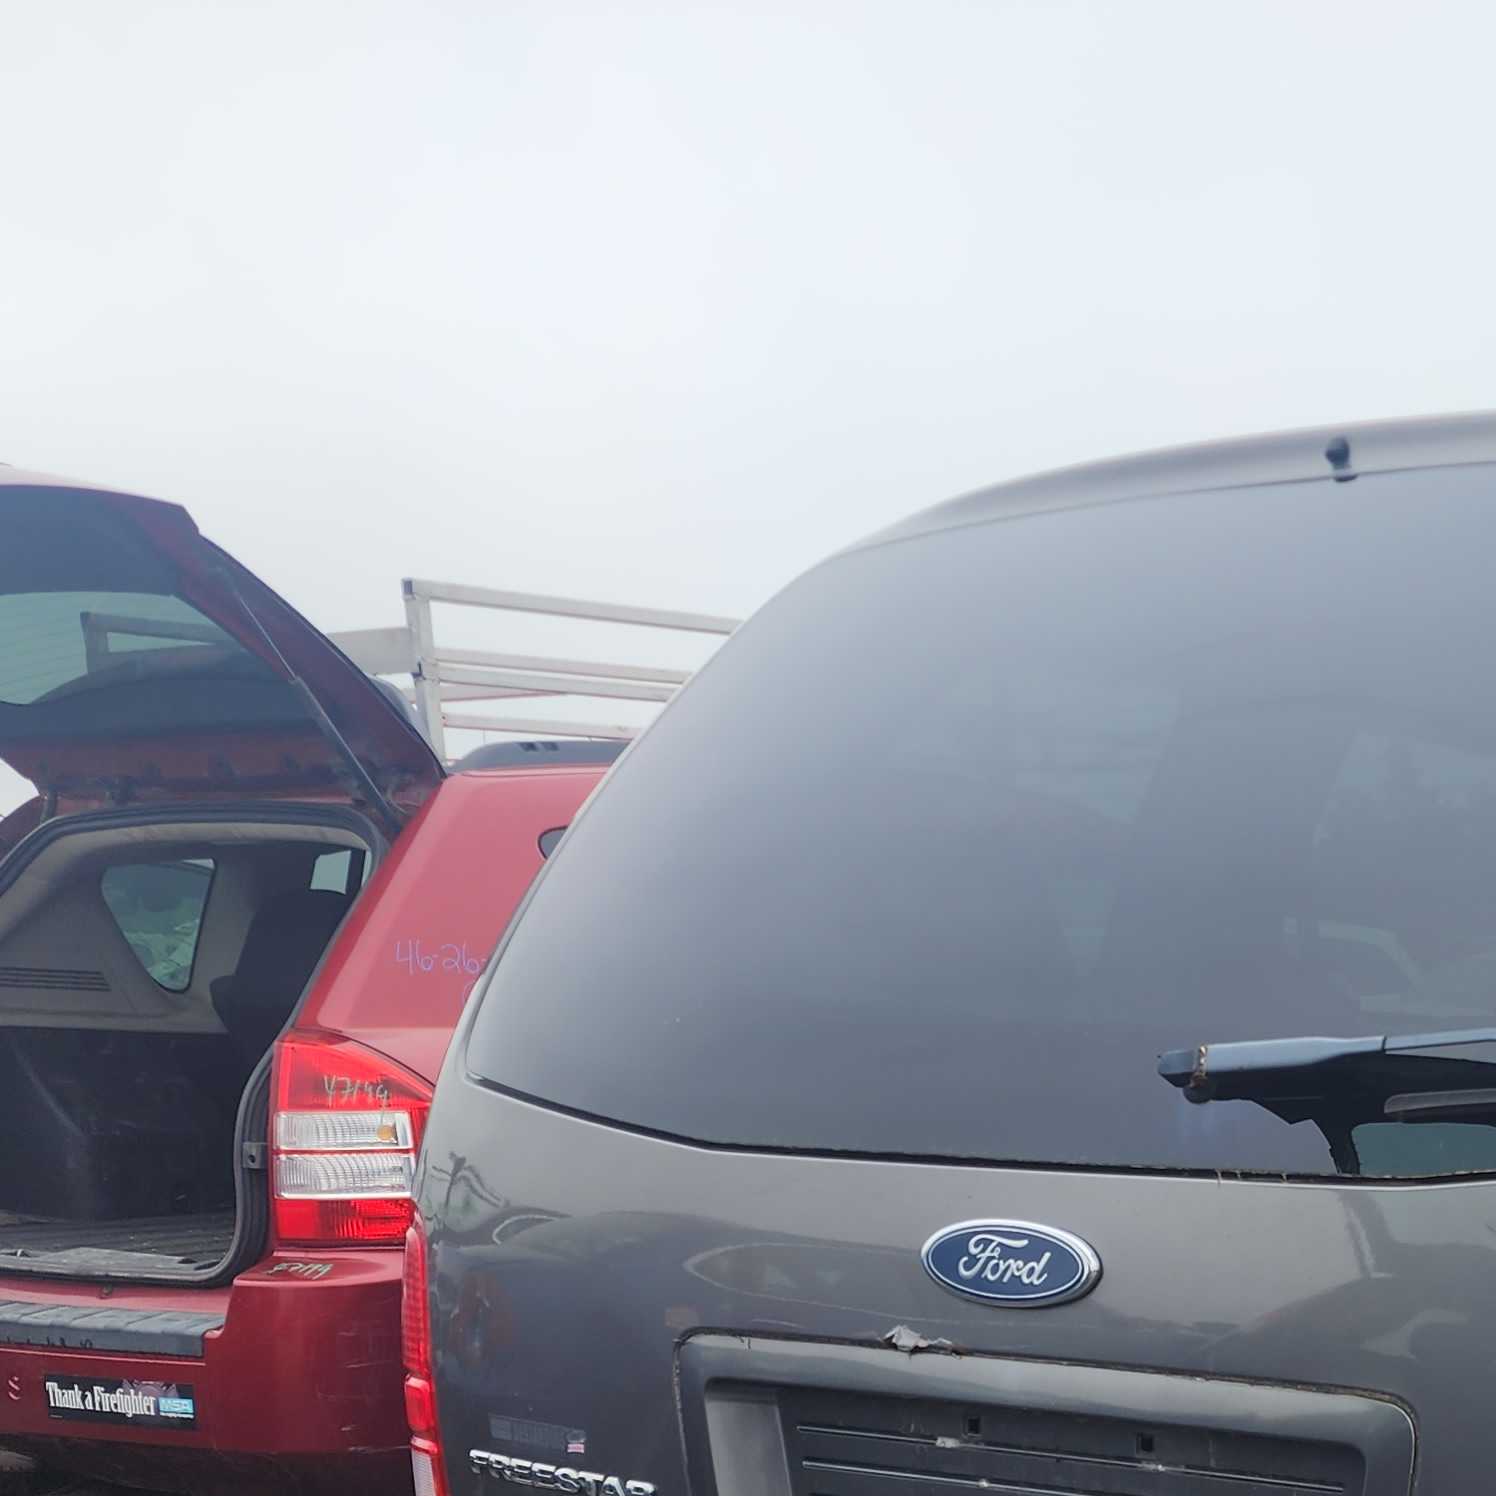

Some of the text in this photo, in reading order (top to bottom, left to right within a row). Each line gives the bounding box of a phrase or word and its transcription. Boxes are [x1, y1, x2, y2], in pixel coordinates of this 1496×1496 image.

[958, 1233, 1051, 1285] Ford
[46, 1382, 156, 1418] Thank a Firefighter
